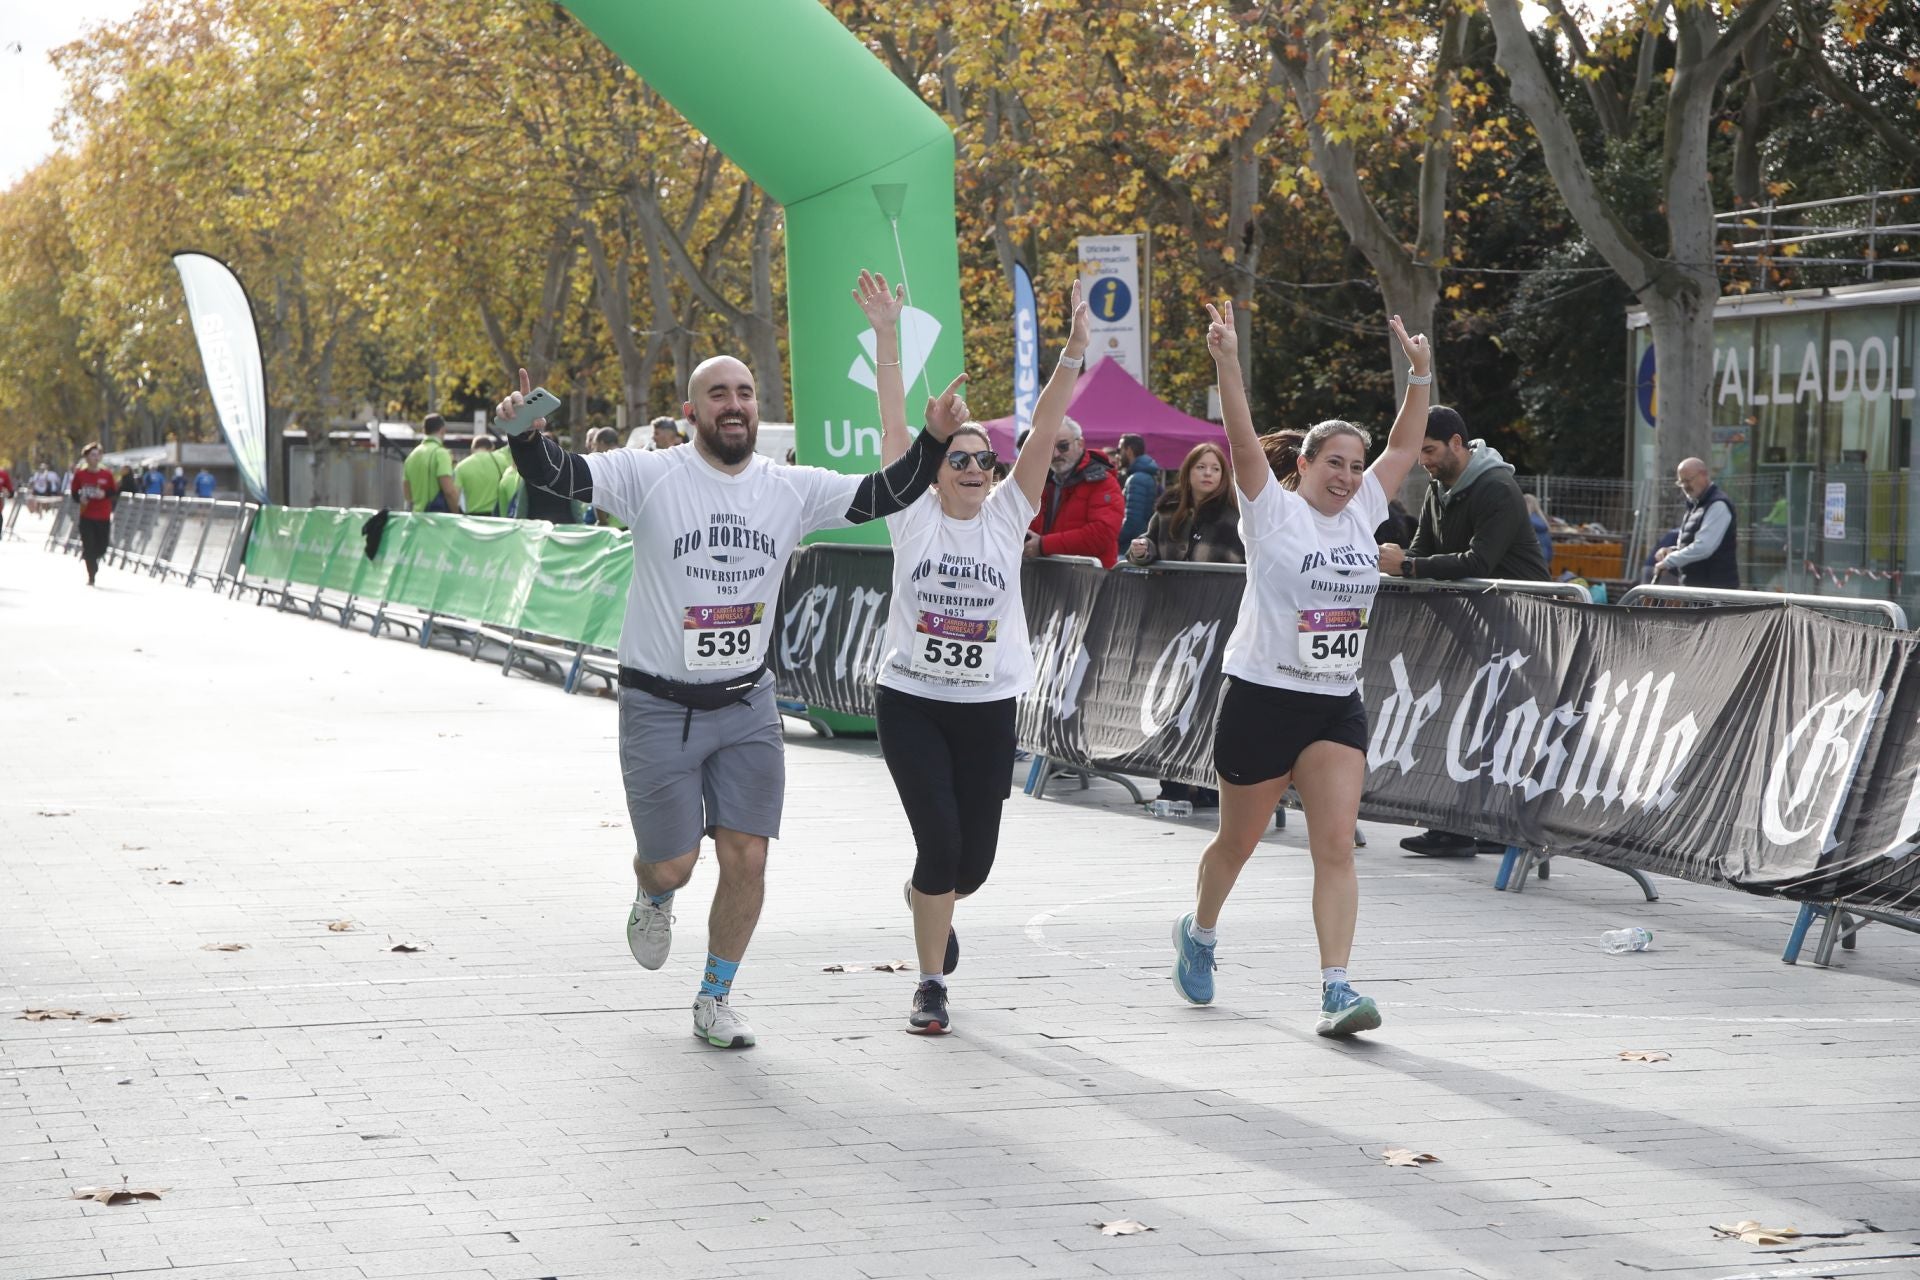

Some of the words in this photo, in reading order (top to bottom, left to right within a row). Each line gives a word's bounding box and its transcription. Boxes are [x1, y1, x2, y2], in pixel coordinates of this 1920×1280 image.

[710, 513, 746, 527] HOSPITAL
[673, 529, 702, 560] RIO
[708, 526, 777, 560] HORTEGA
[941, 553, 975, 566] HOSPITAL
[686, 565, 765, 582] UNIVERSITARIO
[717, 586, 738, 595] 1953
[918, 591, 994, 607] UNIVERSITARIO
[1333, 594, 1352, 604] 1953
[713, 612, 744, 621] EMPRESAS
[944, 609, 965, 617] 1953
[697, 629, 751, 657] 539
[1312, 633, 1359, 660] 540
[924, 638, 983, 669] 538
